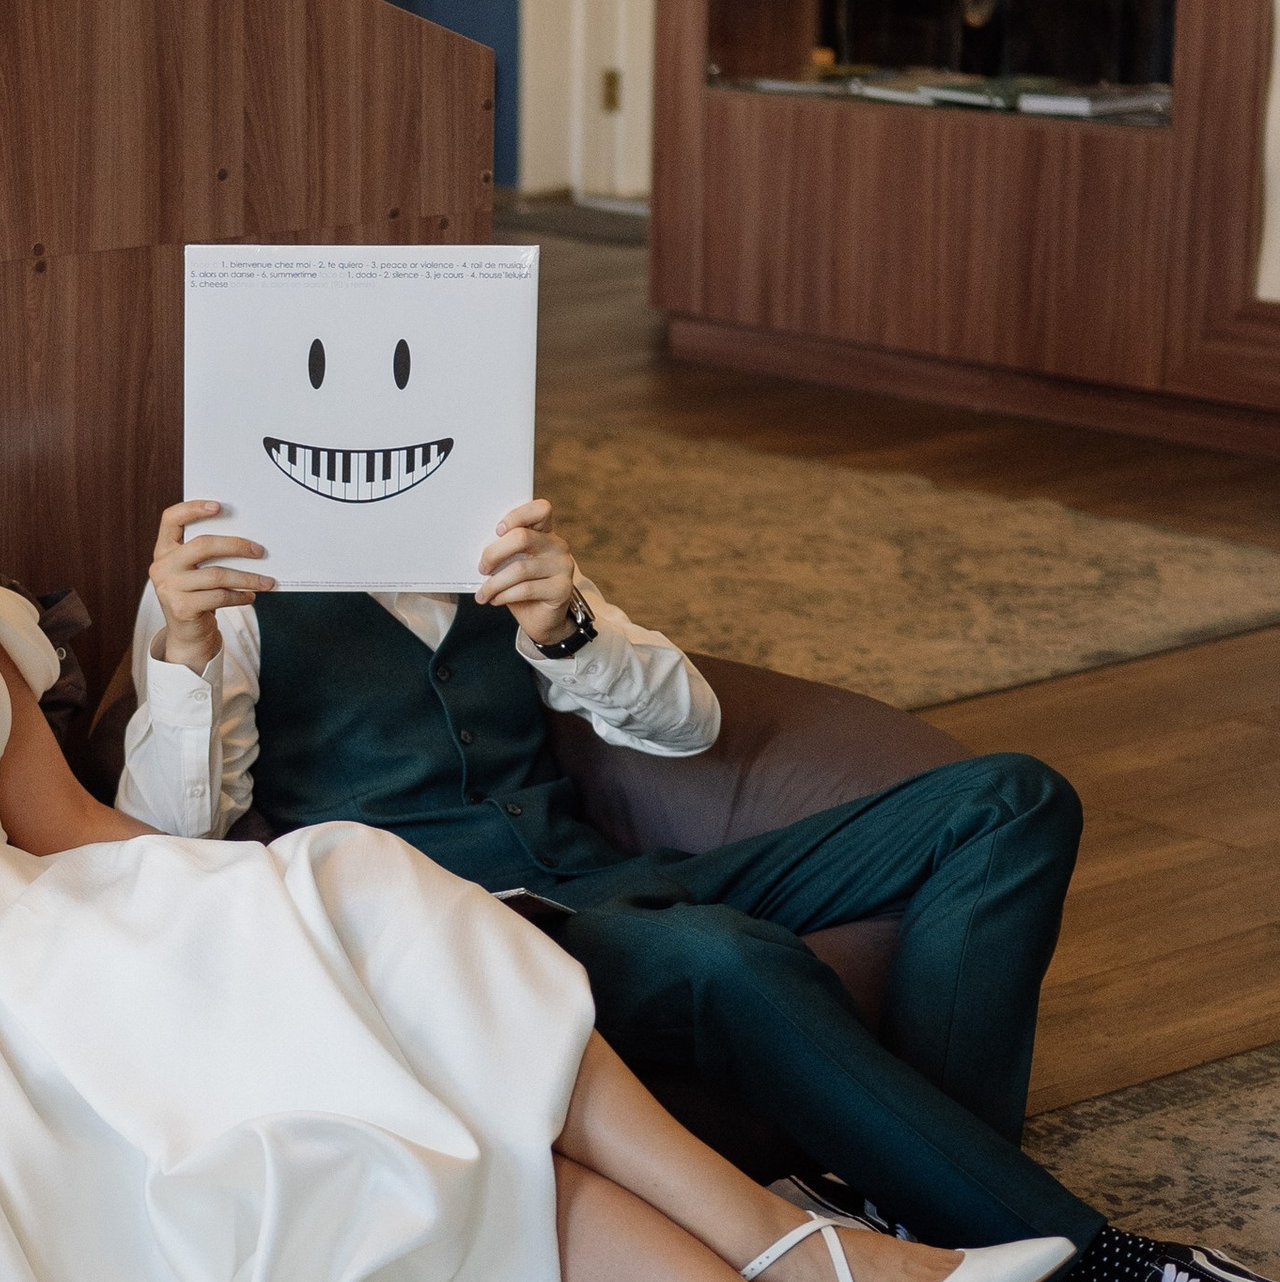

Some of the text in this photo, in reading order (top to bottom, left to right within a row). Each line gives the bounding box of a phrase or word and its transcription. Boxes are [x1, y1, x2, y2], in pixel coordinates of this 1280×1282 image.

[222, 260, 228, 268] 1.
[230, 260, 272, 268] bienvenue
[338, 261, 364, 270] quiero
[380, 262, 407, 270] peace
[190, 270, 197, 278] 5.
[199, 270, 216, 278] alors
[231, 270, 254, 278] danse
[261, 270, 268, 278] 6.
[433, 271, 441, 280] je
[190, 280, 197, 288] 5.
[199, 280, 228, 288] cheese
